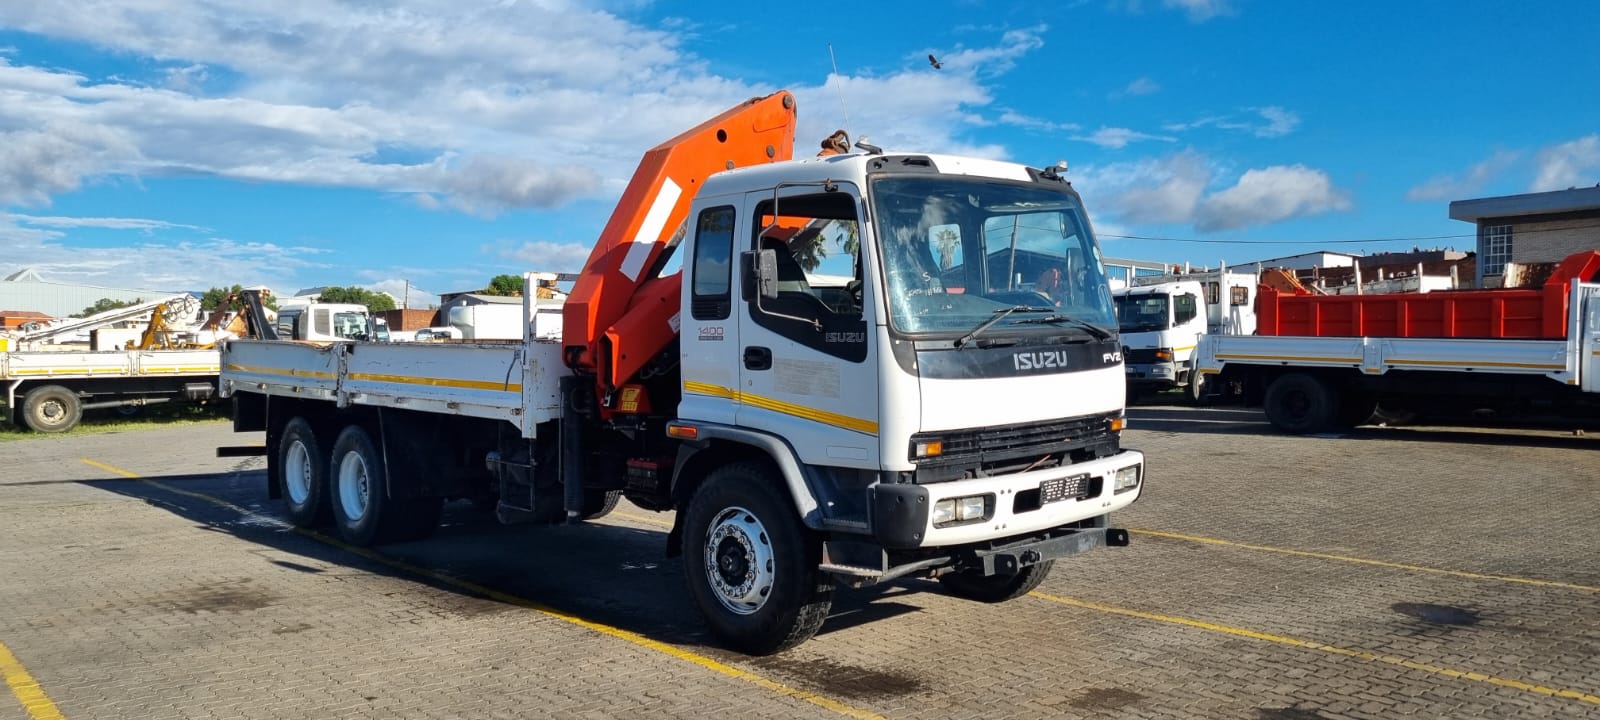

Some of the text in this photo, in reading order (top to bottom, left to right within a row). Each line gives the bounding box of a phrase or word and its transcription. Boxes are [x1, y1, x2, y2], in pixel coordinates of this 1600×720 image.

[698, 326, 724, 336] 1400
[825, 332, 865, 343] ISUZU
[1013, 350, 1068, 370] ISUZU
[1103, 352, 1122, 364] FVZ
